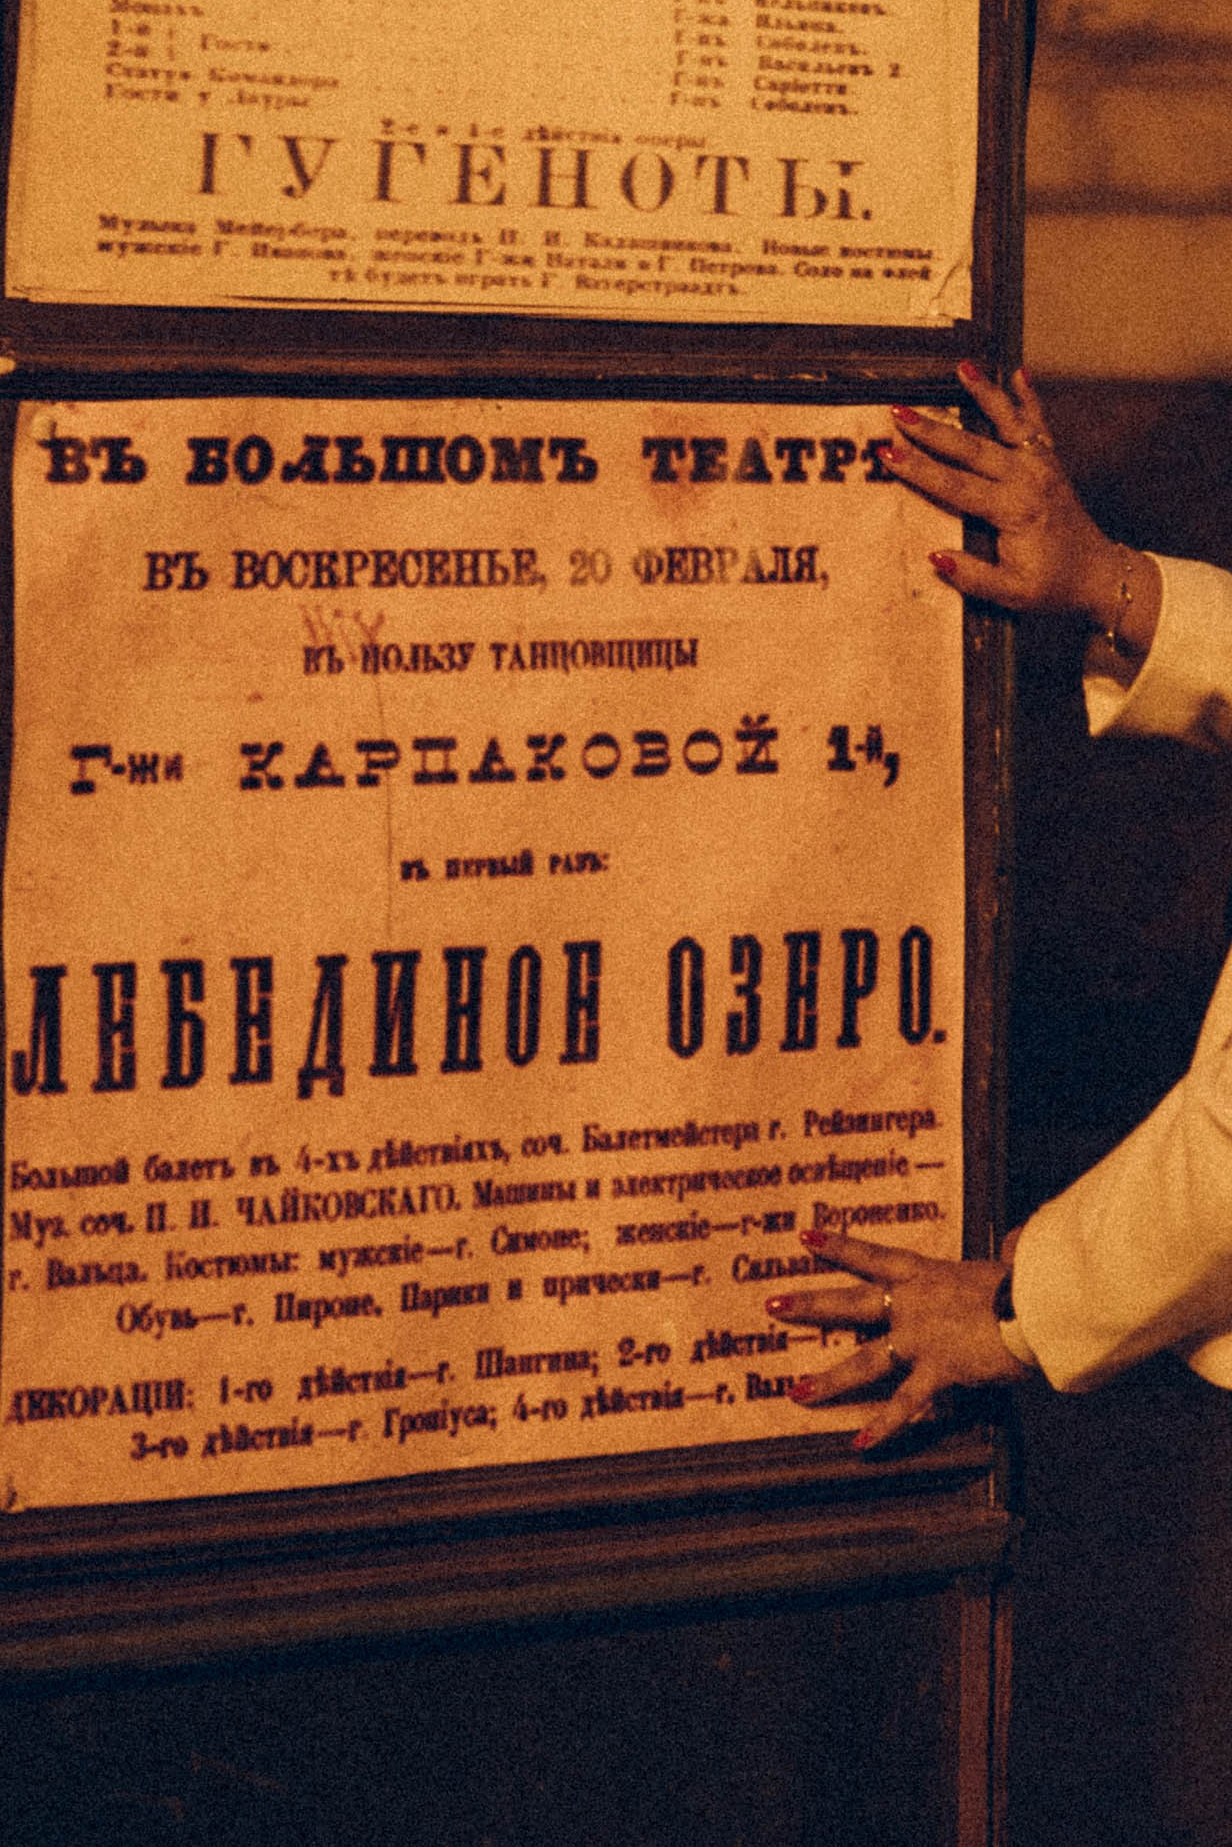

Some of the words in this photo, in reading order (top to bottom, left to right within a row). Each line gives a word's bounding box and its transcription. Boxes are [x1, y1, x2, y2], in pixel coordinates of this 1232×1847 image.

[192, 132, 874, 221] ГУГЕНОТЫ.
[43, 435, 148, 484] ВЪ
[185, 434, 600, 486] БОЛЬШОМЪ
[142, 550, 210, 591] ВЪ
[231, 547, 549, 594] ВОСКРЕСЕНЬЕ,
[568, 548, 613, 586] 20
[633, 544, 830, 591] ФЕВРАЛЯ,
[360, 641, 476, 675] ПОЛЬЗУ
[488, 637, 700, 676] ТАНЦОВЩИЦЫ
[238, 712, 780, 791] КАРПАКОВОЙ
[11, 939, 603, 1100] ЛЕБЕДИНОЕ
[667, 924, 948, 1059] ОЗЕРО.
[10, 1156, 130, 1191] Большой
[143, 1153, 236, 1184] балетъ
[249, 1153, 281, 1177] въ
[521, 1132, 570, 1158] соч.
[582, 1119, 760, 1153] Балетмейстера
[79, 1210, 135, 1236] соч.
[145, 1201, 177, 1233] П.
[236, 1184, 461, 1227] ЧАЙКОВСКАГО.
[472, 1178, 577, 1209] Машины
[585, 1177, 601, 1200] и
[611, 1163, 782, 1203] электрическое
[787, 1147, 910, 1186] освѣщеніе
[165, 1249, 299, 1281] Костюмы:
[400, 1281, 490, 1318] Парики
[507, 1277, 523, 1301] и
[219, 1373, 274, 1405] 1-го
[617, 1336, 672, 1368] 2-го
[130, 1430, 189, 1461] 3-го
